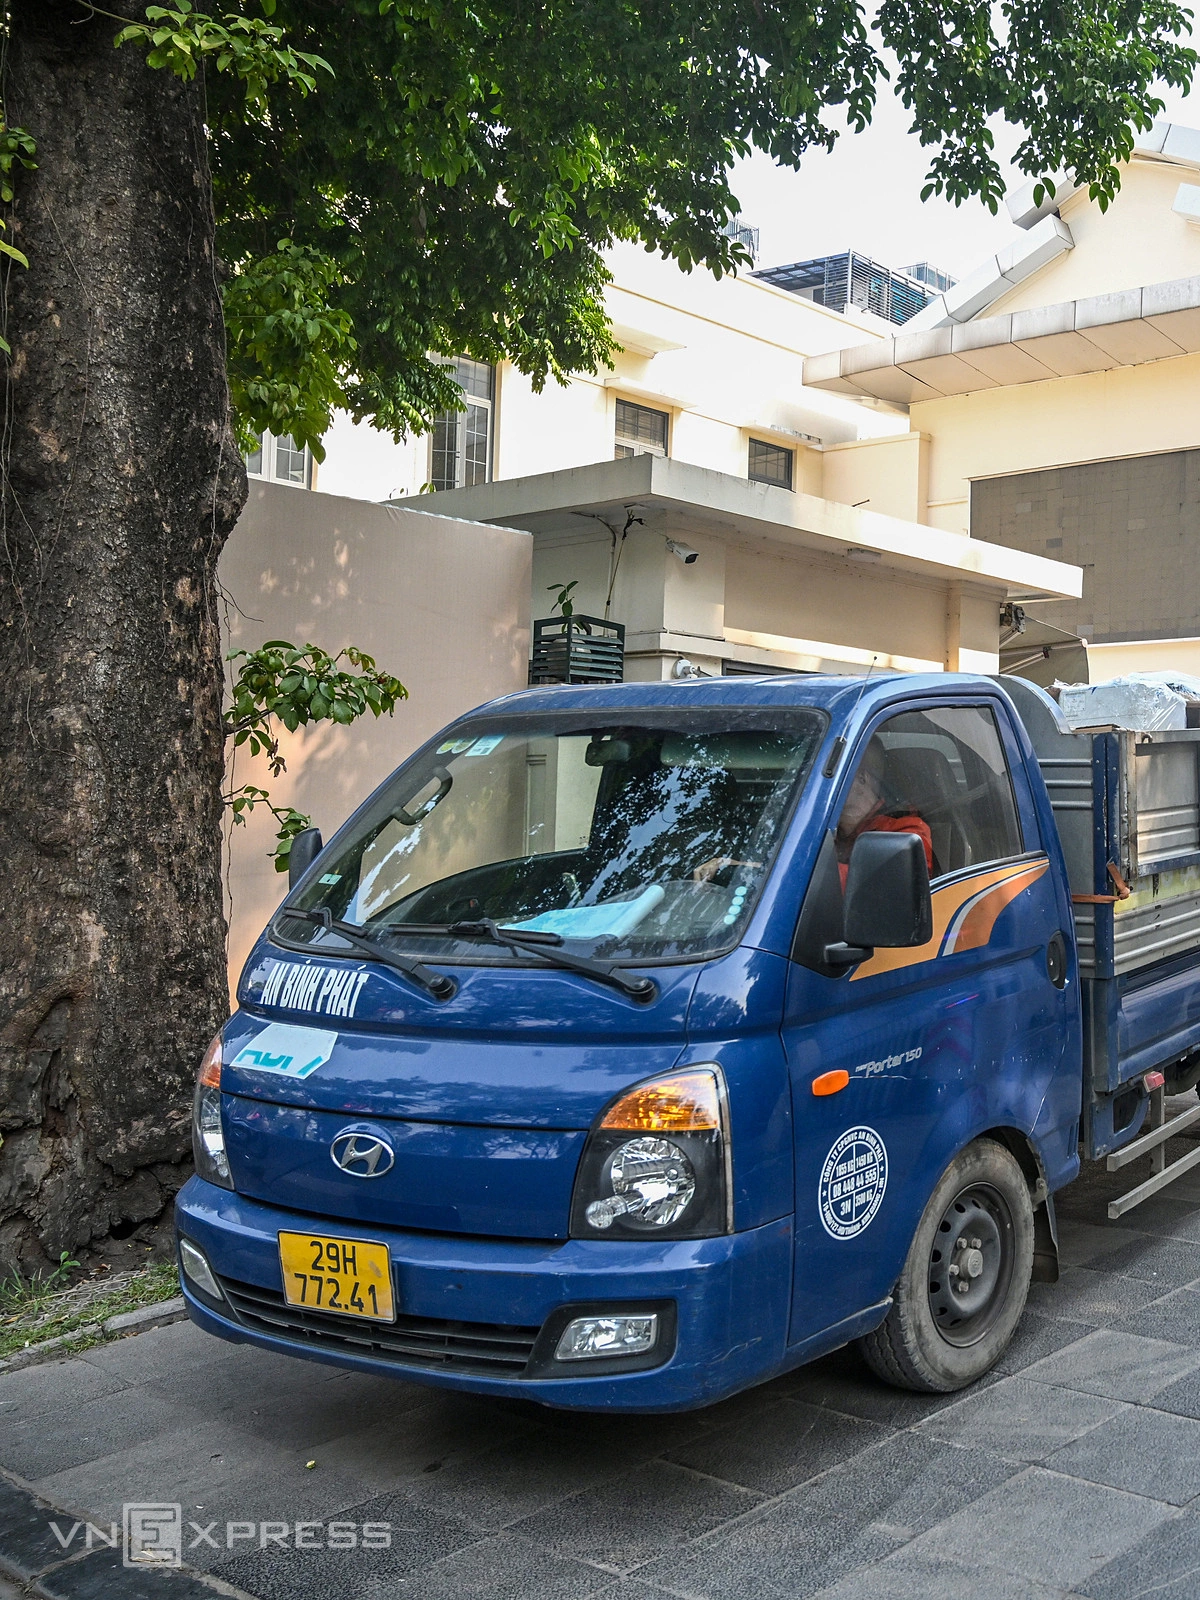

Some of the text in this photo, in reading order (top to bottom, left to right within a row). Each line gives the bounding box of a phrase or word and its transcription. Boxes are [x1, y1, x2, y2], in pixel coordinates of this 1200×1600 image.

[260, 962, 290, 1006] AN
[316, 965, 370, 1018] PHÁT
[865, 1053, 905, 1078] Porter
[905, 1047, 923, 1063] 150
[831, 1150, 839, 1160] TY
[858, 1131, 866, 1140] AN
[866, 1151, 873, 1164] KG
[843, 1177, 855, 1193] 448
[856, 1174, 864, 1187] 44
[865, 1168, 876, 1184] 555
[847, 1159, 854, 1173] KG
[310, 1241, 357, 1276] 29H
[294, 1273, 378, 1315] 772.41
